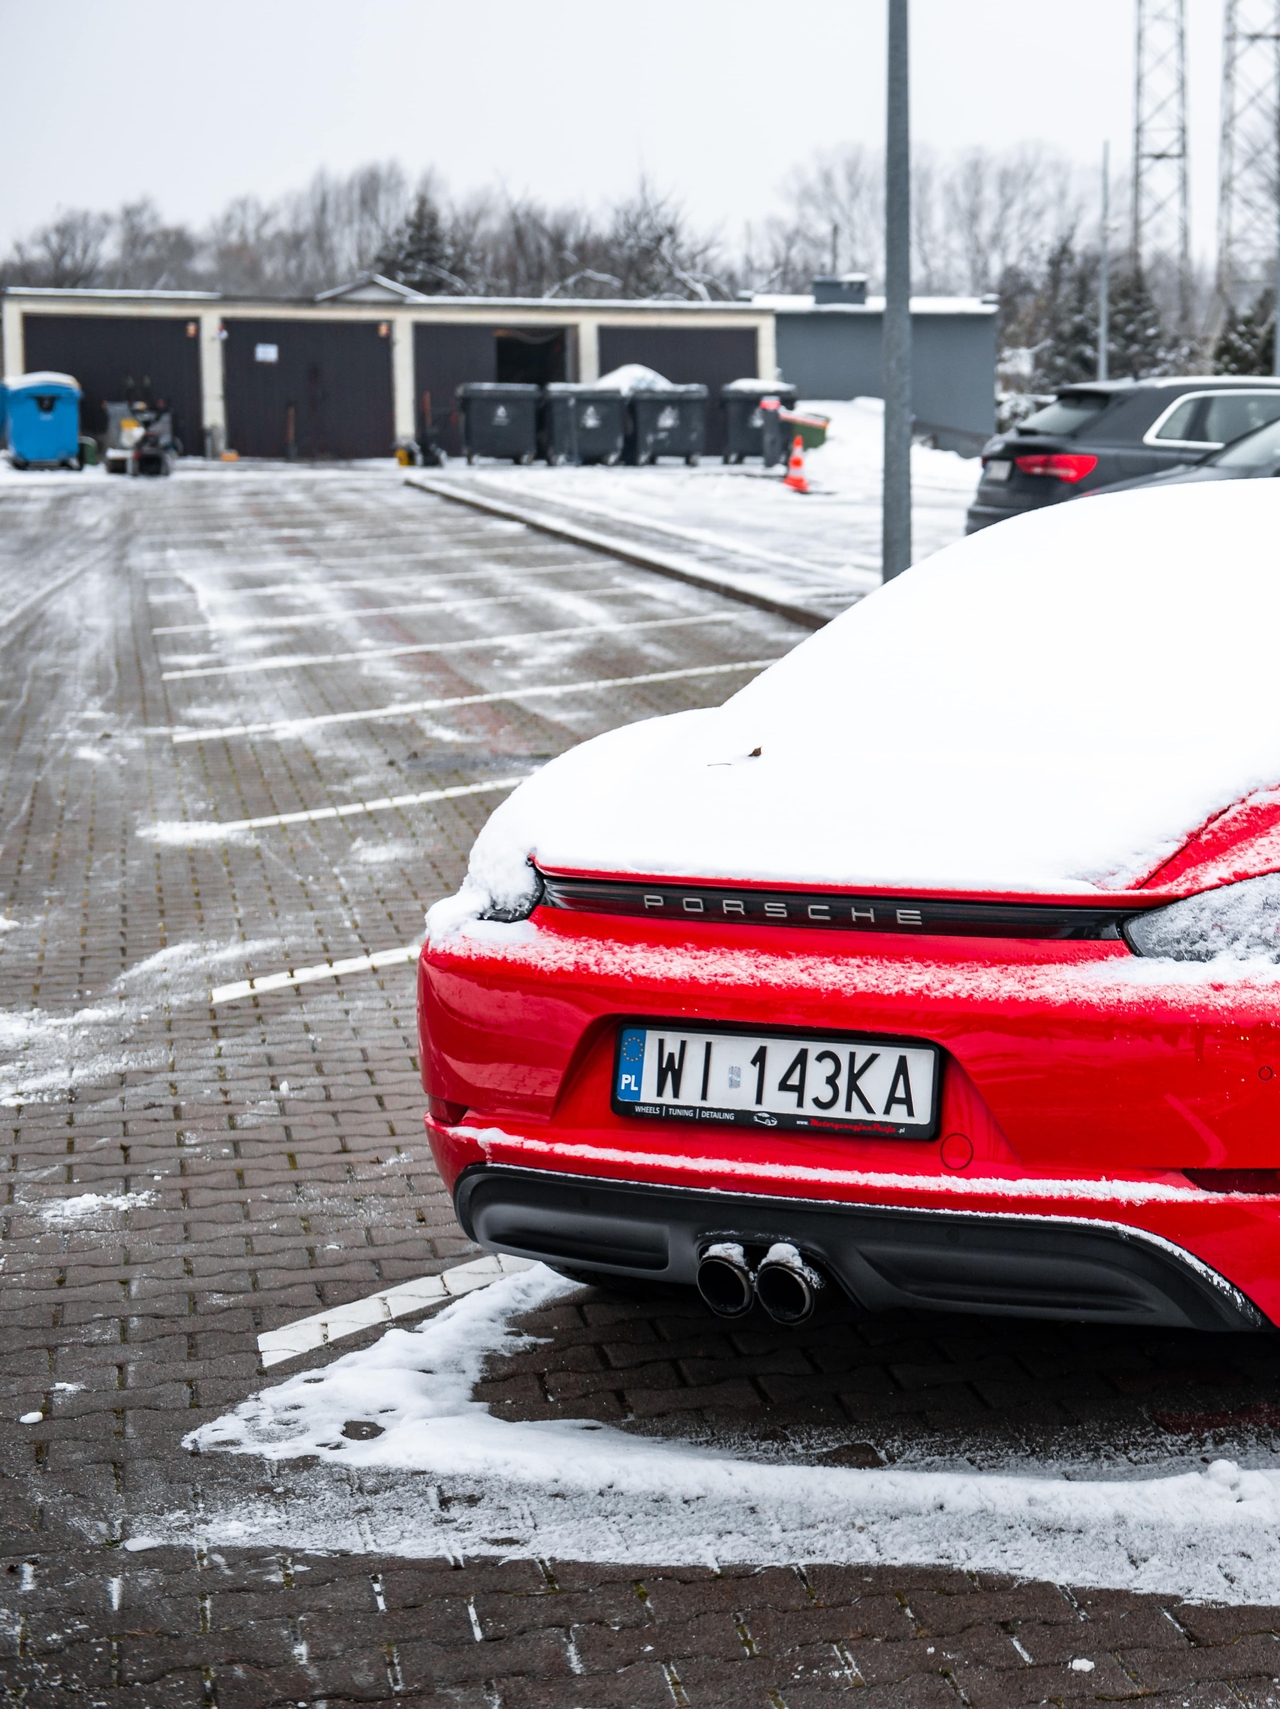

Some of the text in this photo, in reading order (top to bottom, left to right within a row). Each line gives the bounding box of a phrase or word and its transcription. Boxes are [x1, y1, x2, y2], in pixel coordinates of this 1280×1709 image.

[643, 893, 923, 926] PORSCHE
[620, 1073, 639, 1092] PL
[655, 1037, 917, 1118] WI 143KA
[634, 1105, 736, 1121] WHEELS TUNING DETAILING
